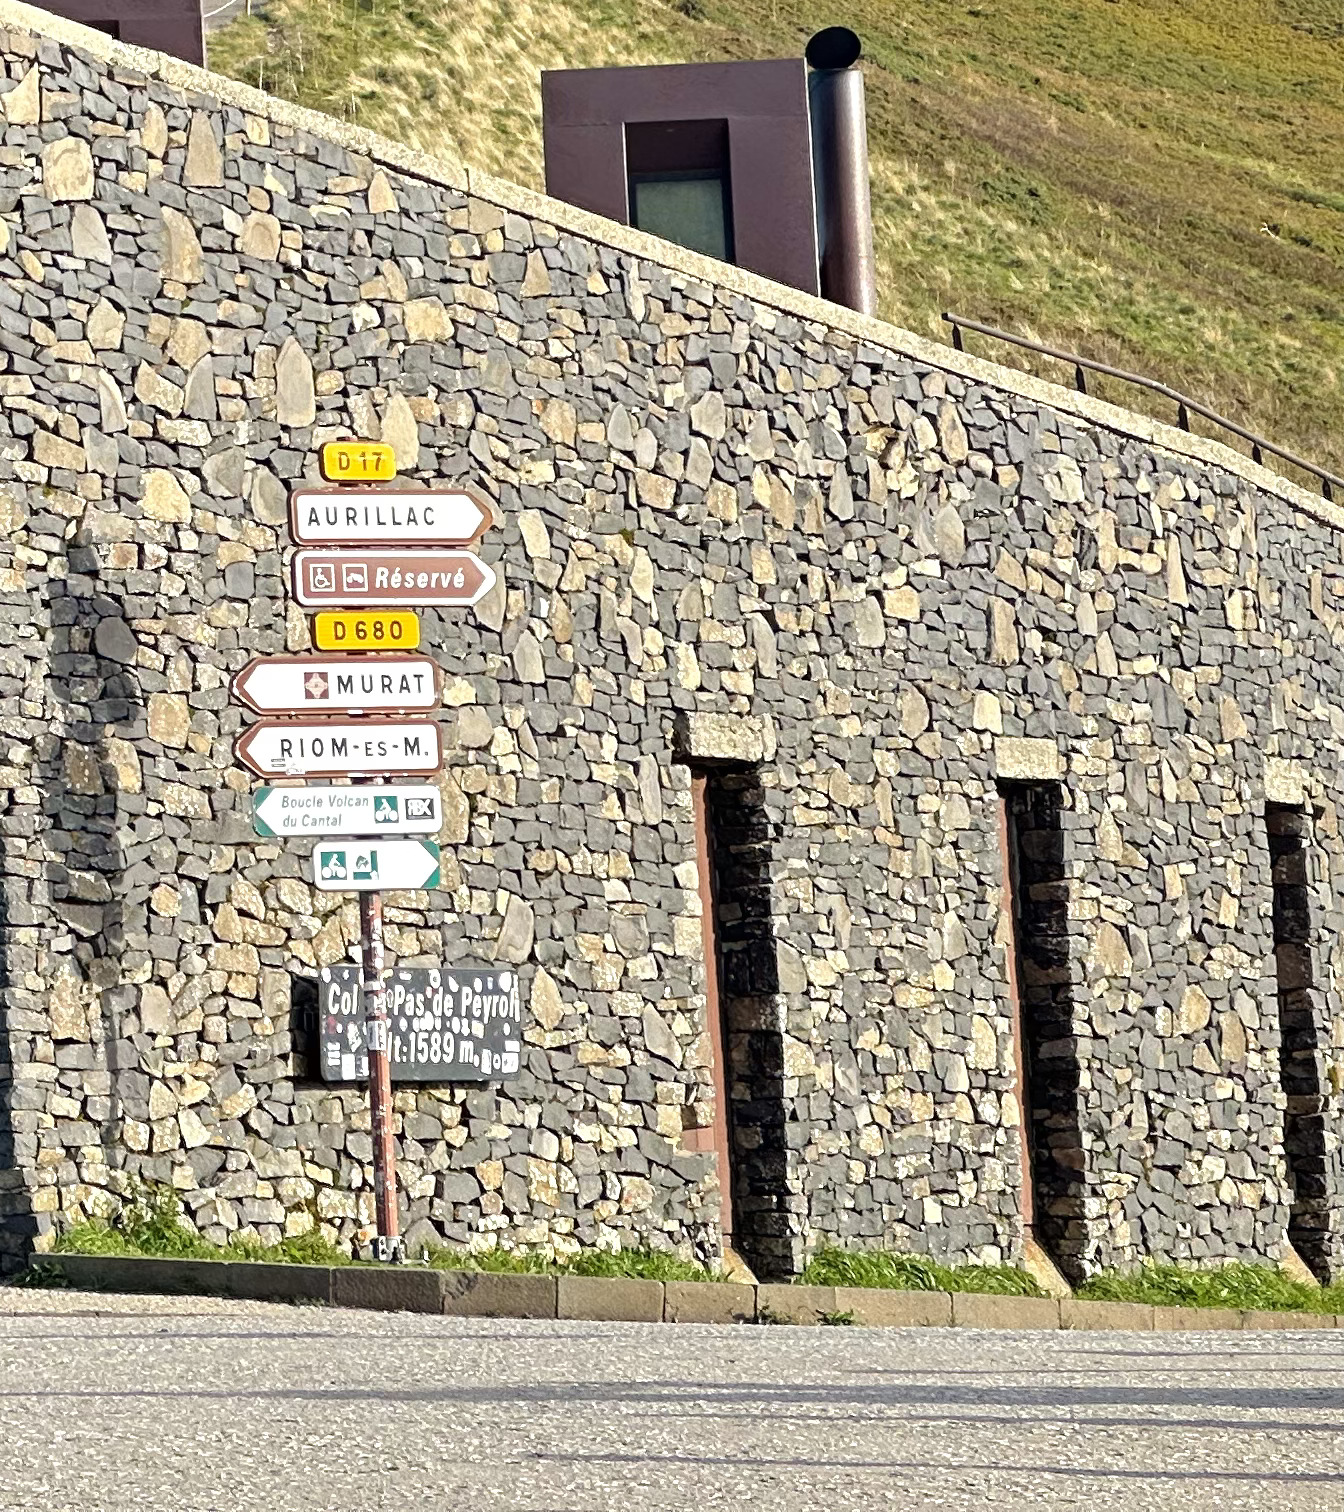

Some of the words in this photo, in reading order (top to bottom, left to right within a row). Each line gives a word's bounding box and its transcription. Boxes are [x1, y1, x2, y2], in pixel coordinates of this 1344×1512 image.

[338, 451, 351, 472] D
[359, 451, 384, 472] 17
[307, 506, 435, 526] AURILLAC
[375, 567, 465, 589] Réservé
[333, 620, 347, 641] D
[355, 620, 403, 641] 680
[338, 674, 424, 695] MURAT
[282, 795, 323, 808] Boucle
[329, 794, 369, 808] Volcan
[283, 814, 297, 828] du
[301, 813, 342, 827] Cantal
[328, 982, 359, 1016] Col
[393, 984, 425, 1016] Pas
[432, 986, 454, 1017] de
